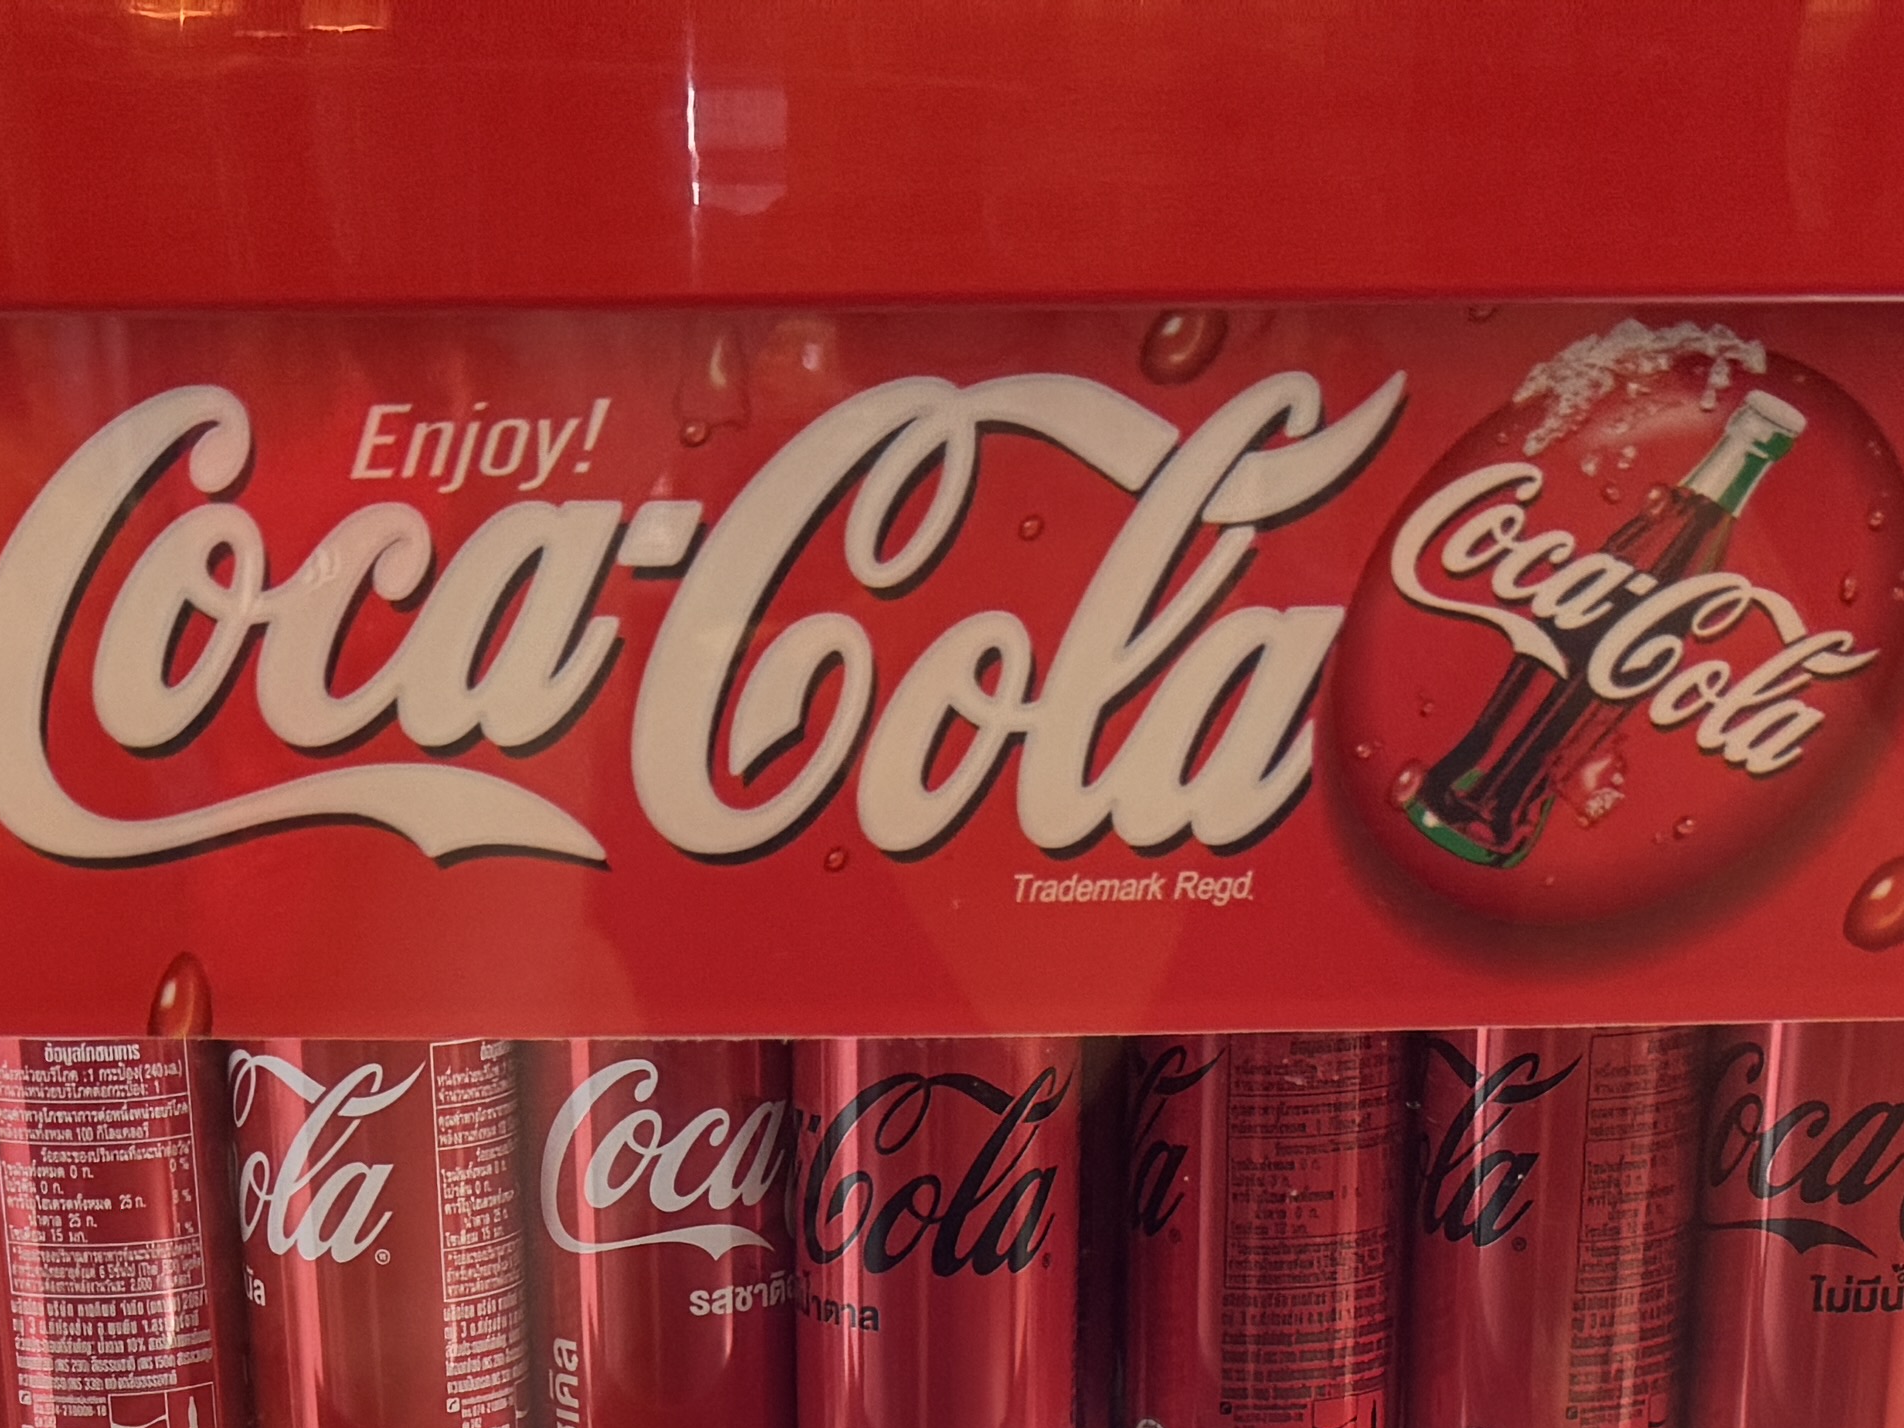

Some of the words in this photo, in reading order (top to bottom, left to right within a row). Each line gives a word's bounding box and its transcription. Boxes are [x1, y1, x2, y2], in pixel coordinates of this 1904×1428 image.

[352, 398, 610, 492] Enjoy!
[1391, 462, 1880, 775] Coca-Cola
[1014, 872, 1164, 903] Trademark
[1174, 870, 1254, 906] Regd.
[76, 1127, 94, 1141] 100
[51, 1229, 64, 1242] 15
[689, 1268, 794, 1317] รสชาติ
